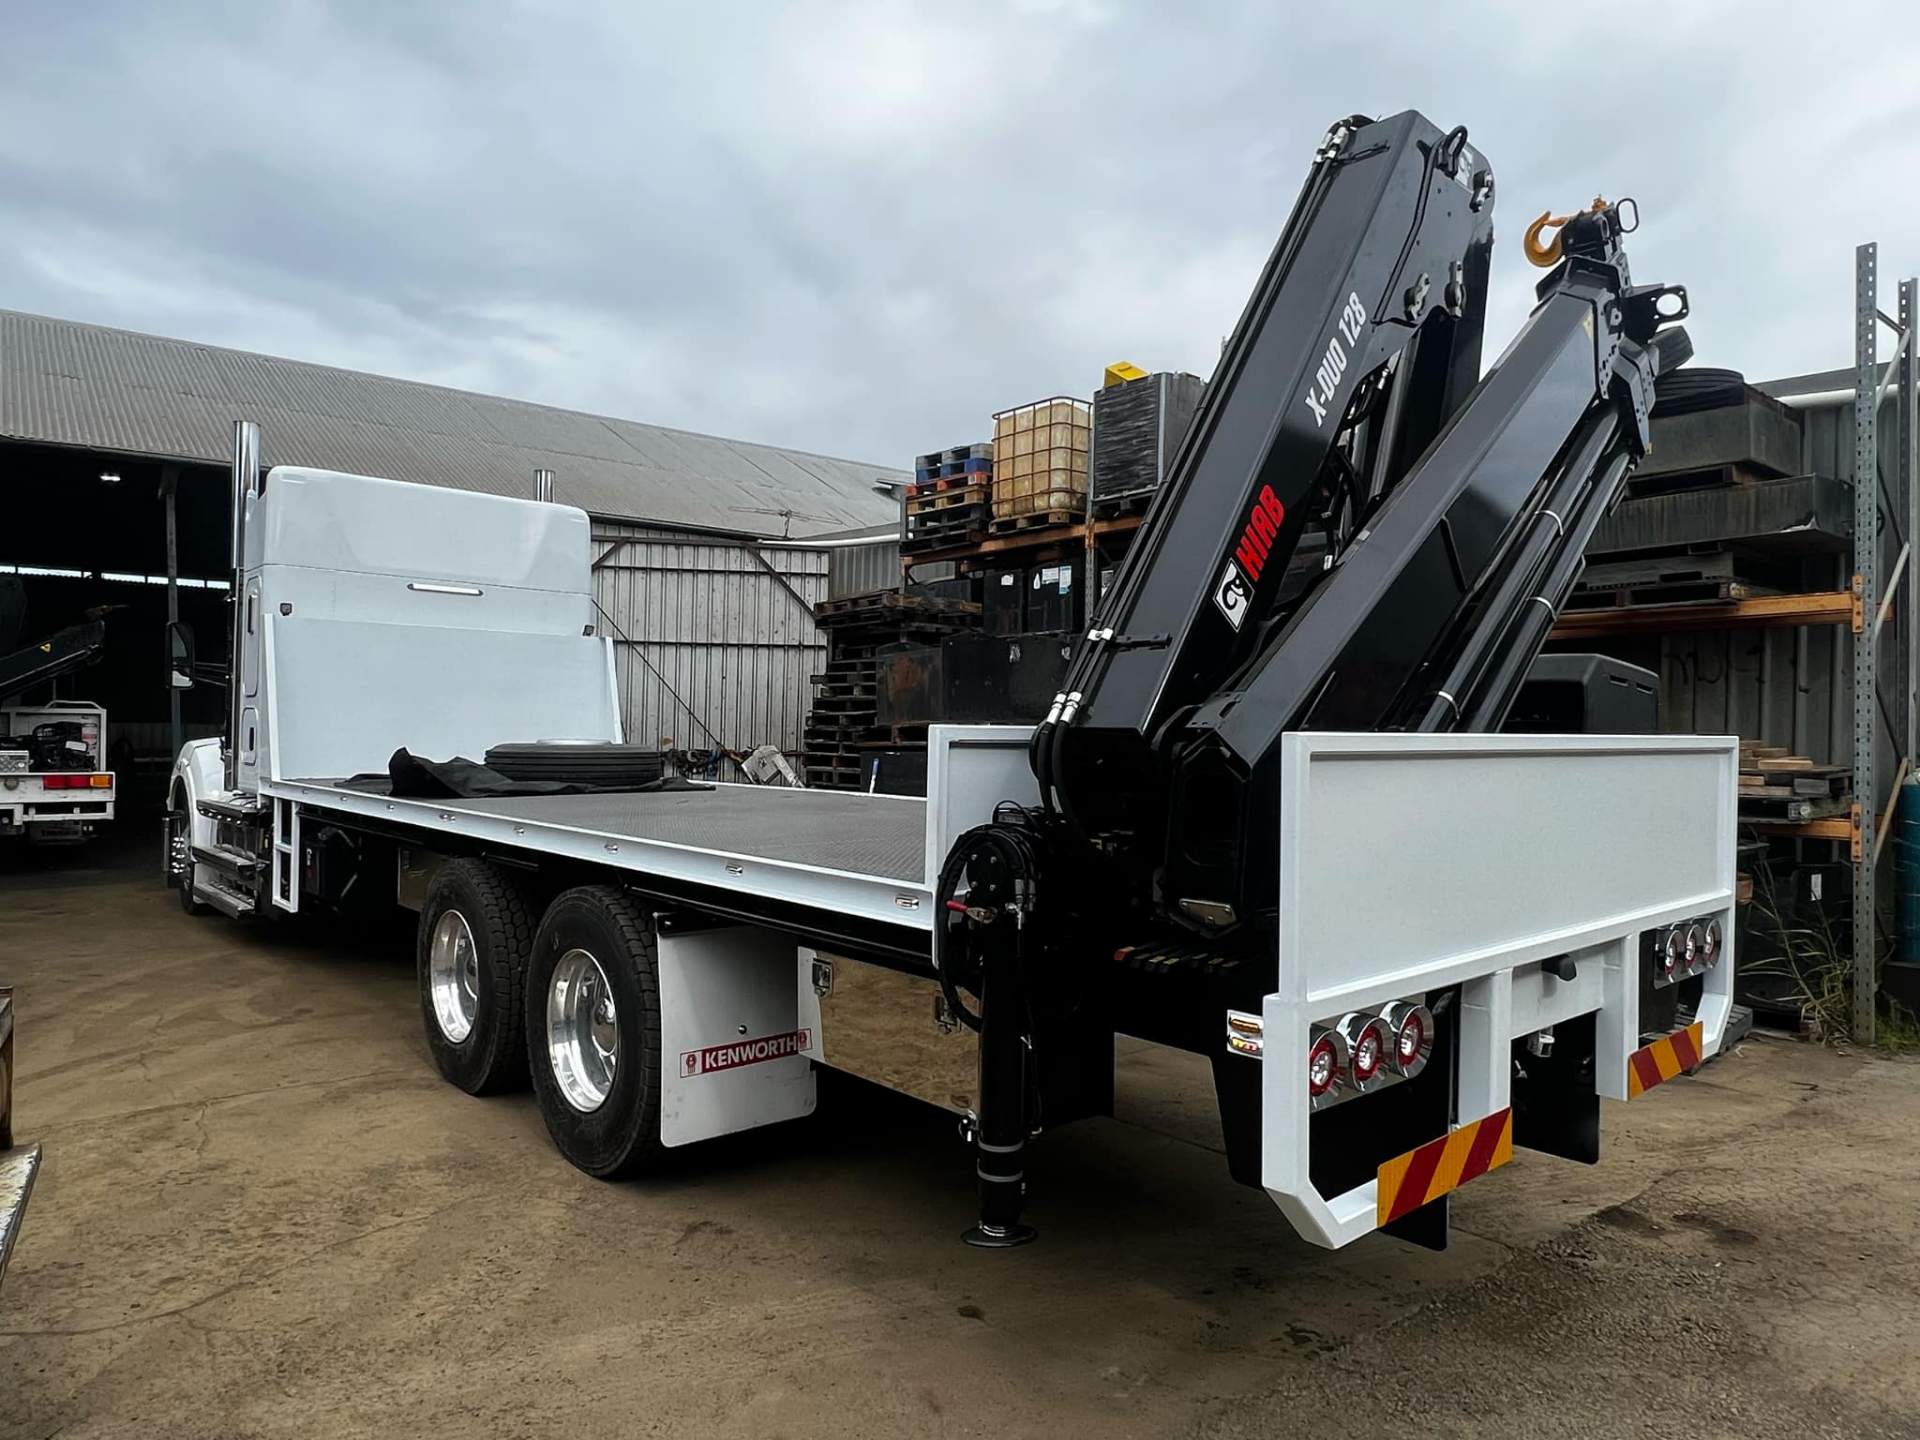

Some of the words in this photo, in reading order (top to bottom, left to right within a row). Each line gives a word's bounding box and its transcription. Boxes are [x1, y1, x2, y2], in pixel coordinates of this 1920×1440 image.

[1305, 338, 1347, 427] X-DUO
[1339, 292, 1366, 348] 128
[1236, 485, 1285, 581] HIAB
[705, 1037, 797, 1069] KENWORTH
